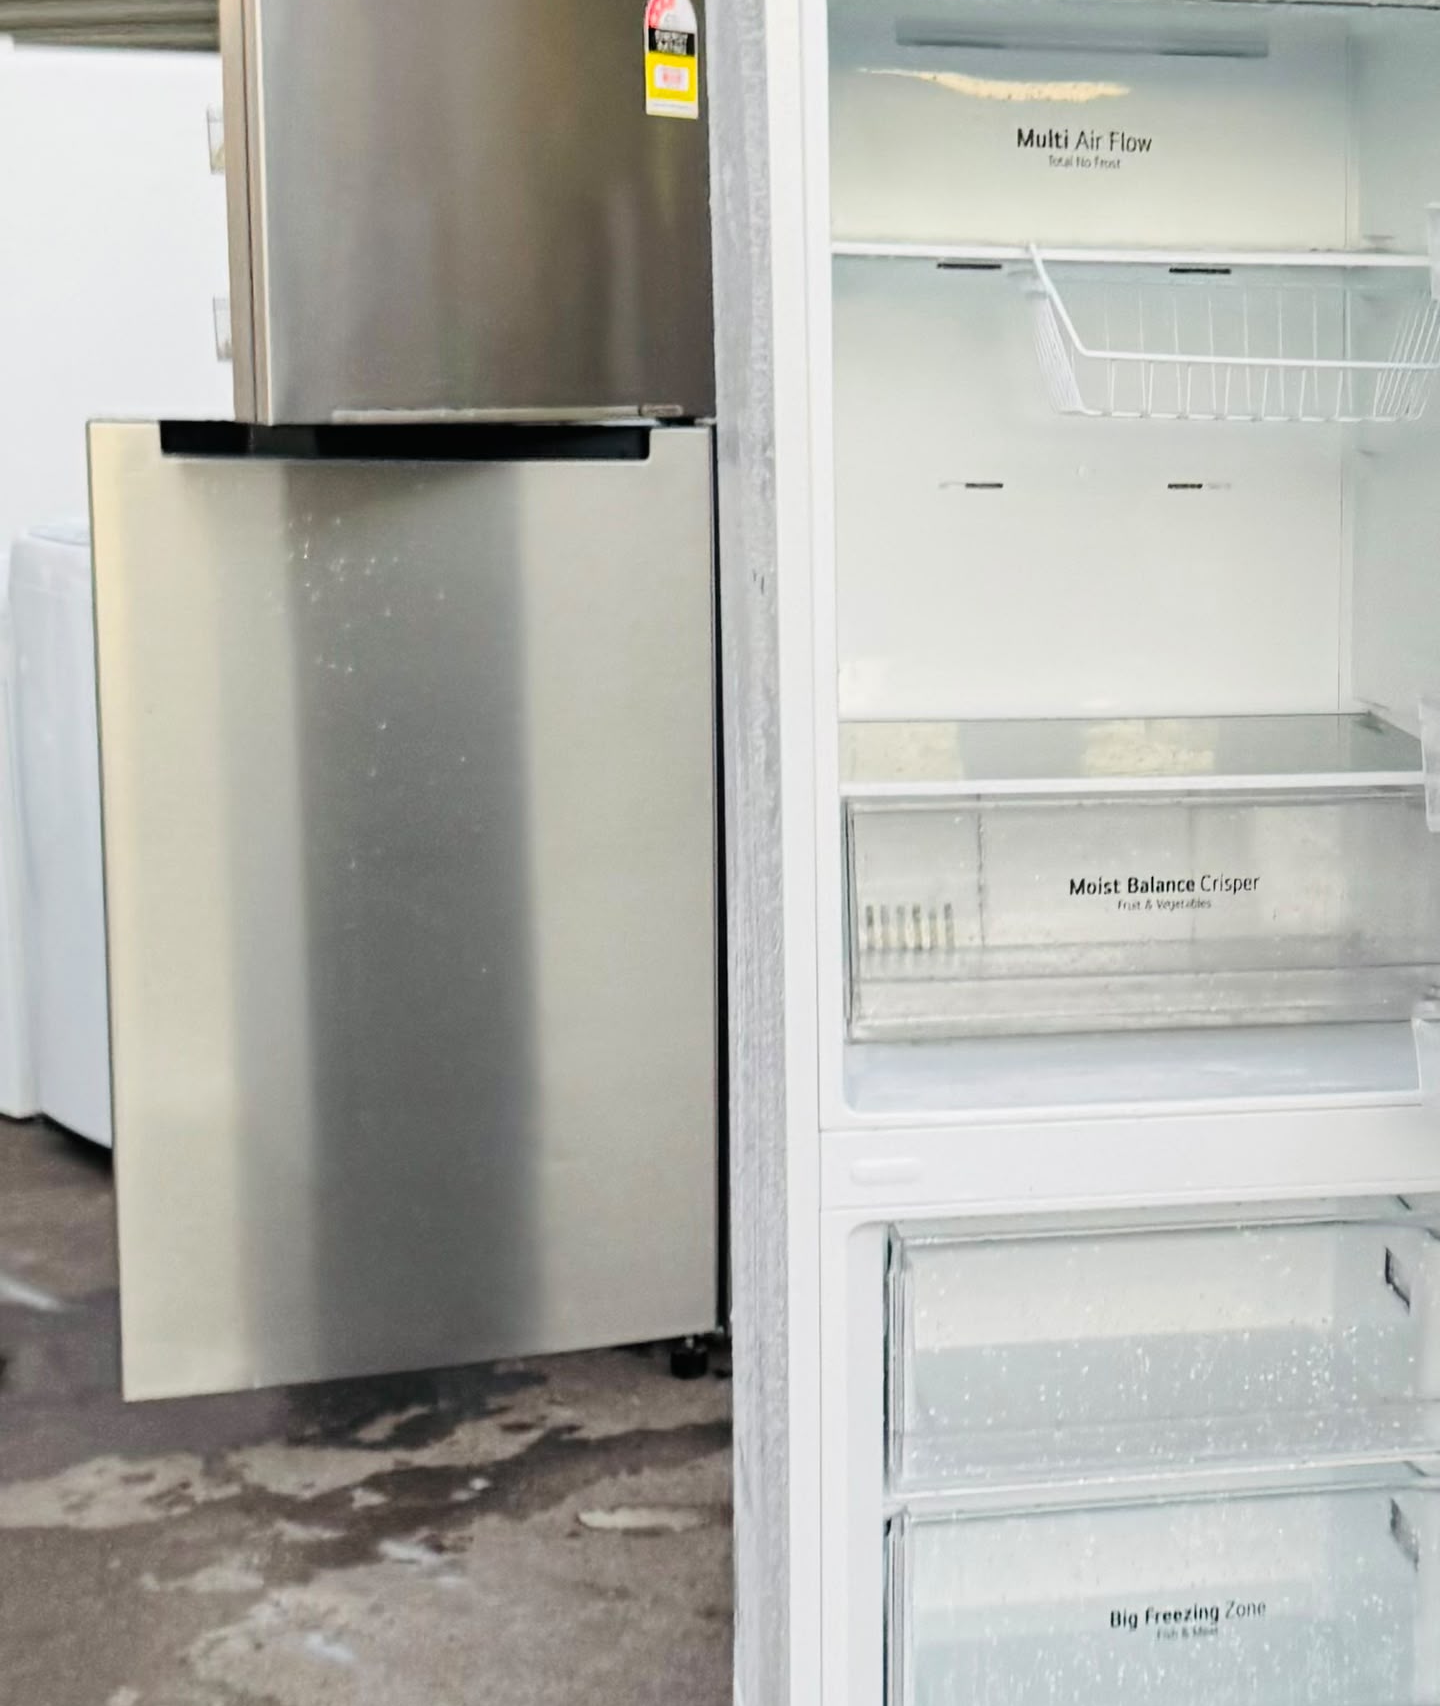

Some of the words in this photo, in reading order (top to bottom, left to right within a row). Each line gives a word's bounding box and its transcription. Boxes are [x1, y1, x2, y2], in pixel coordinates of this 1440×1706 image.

[1017, 128, 1069, 150] Multi
[1075, 131, 1104, 151] Air
[1109, 131, 1153, 153] Flow
[1048, 155, 1074, 168] Total
[1069, 877, 1121, 896] Moist
[1127, 876, 1196, 894] Balance
[1200, 873, 1261, 895] Crisper
[1156, 898, 1213, 912] Vegetables
[1110, 1608, 1138, 1631] Big
[1145, 1602, 1220, 1626] Freezing
[1224, 1599, 1267, 1620] Zone
